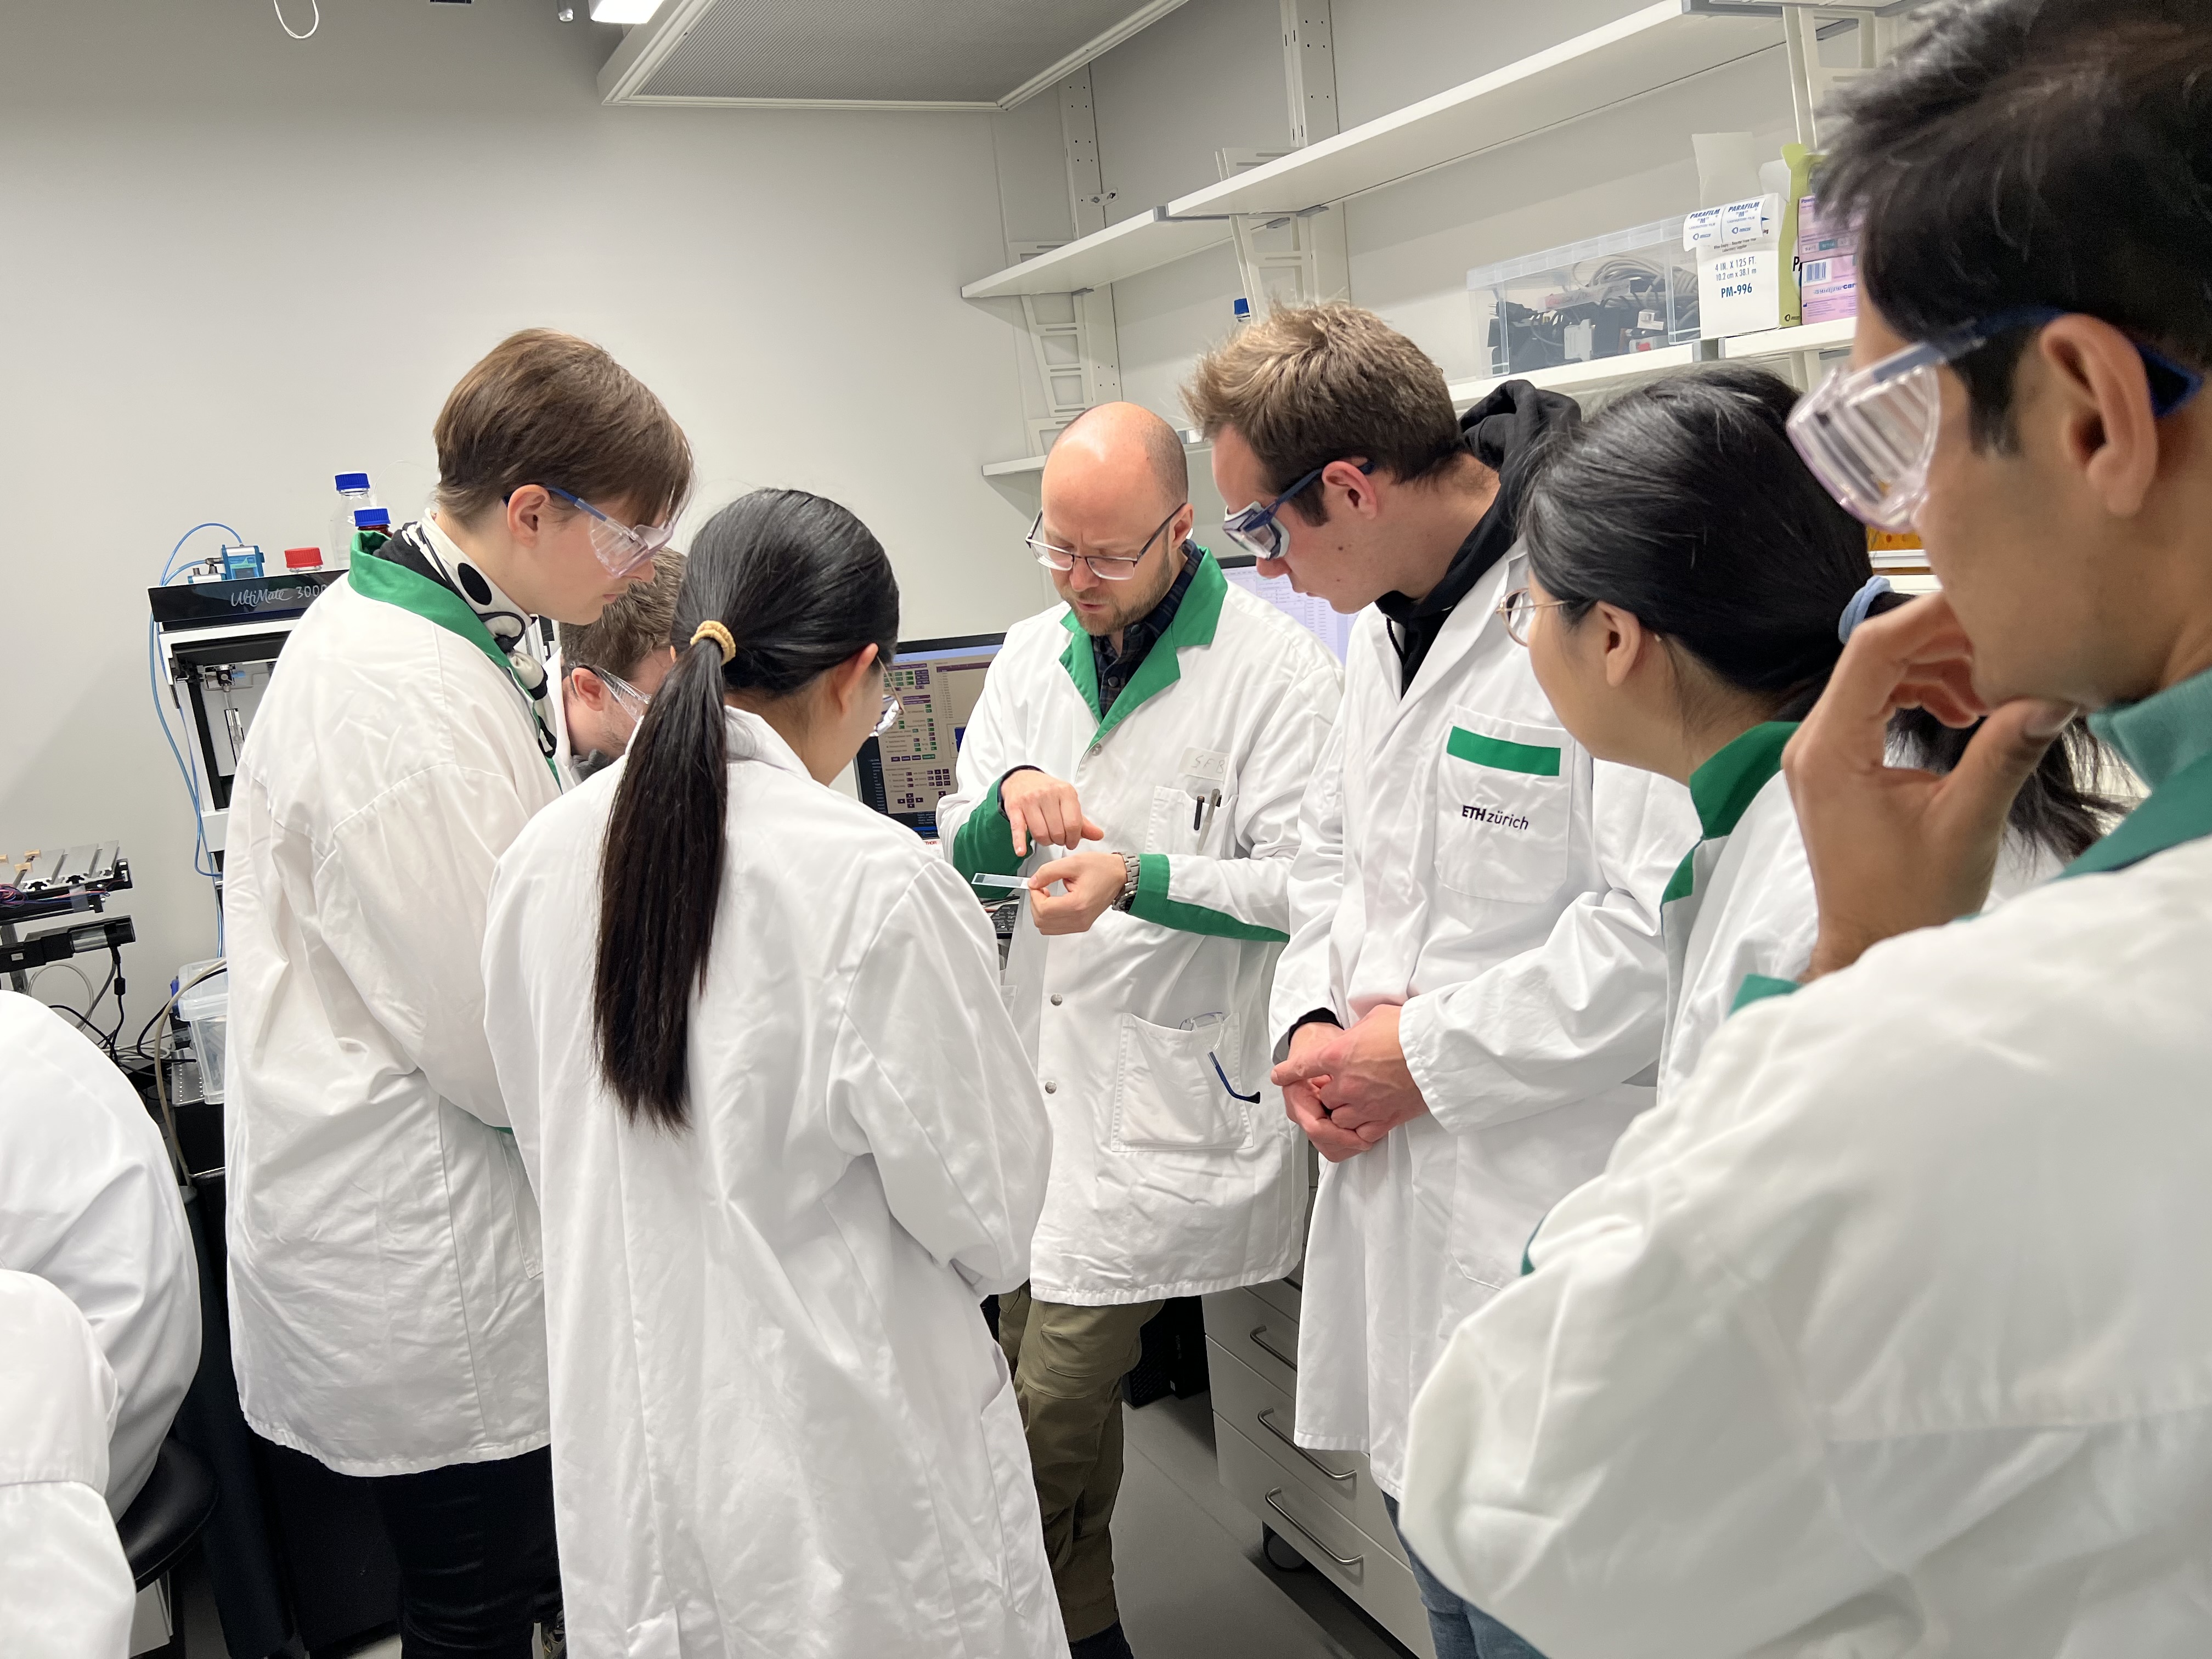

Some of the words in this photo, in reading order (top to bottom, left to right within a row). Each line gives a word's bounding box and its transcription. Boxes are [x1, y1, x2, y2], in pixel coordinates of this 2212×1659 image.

[1690, 208, 1720, 219] PARAFILM
[1728, 202, 1760, 212] PARAFILM
[1715, 263, 1718, 272] 4
[1730, 261, 1734, 269] X
[1736, 258, 1746, 267] 125
[1716, 273, 1726, 281] 10.2
[1739, 267, 1750, 276] 38.1
[1721, 283, 1752, 298] PM-996
[230, 588, 294, 607] UltiMate
[1462, 805, 1487, 821] ETH
[1486, 810, 1528, 830] zürich
